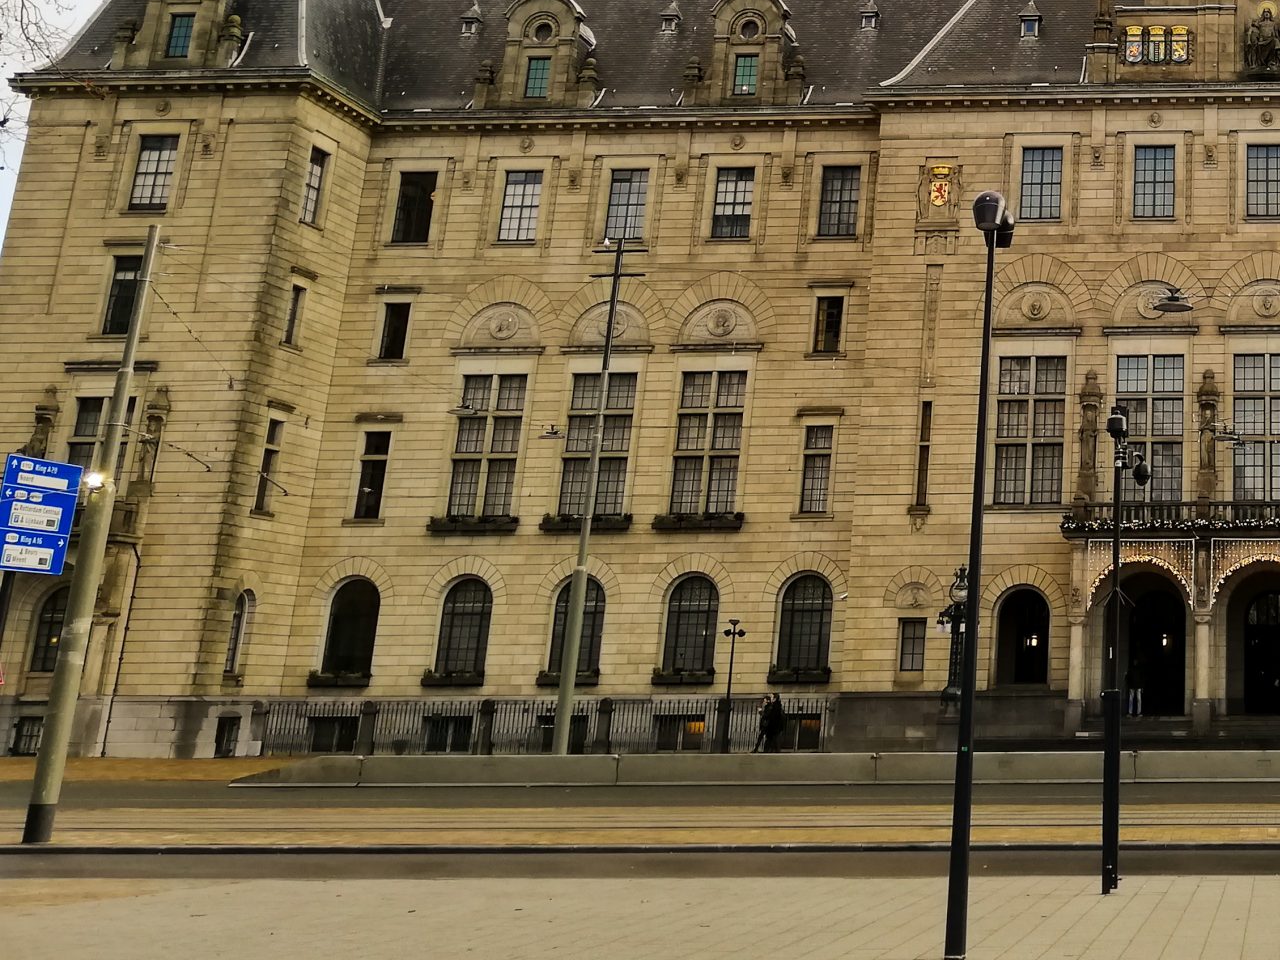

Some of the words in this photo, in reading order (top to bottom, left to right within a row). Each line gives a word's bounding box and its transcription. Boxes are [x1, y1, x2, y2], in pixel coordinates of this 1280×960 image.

[35, 464, 46, 474] Ring
[20, 504, 42, 513] Rotterdam
[20, 536, 32, 545] Ring
